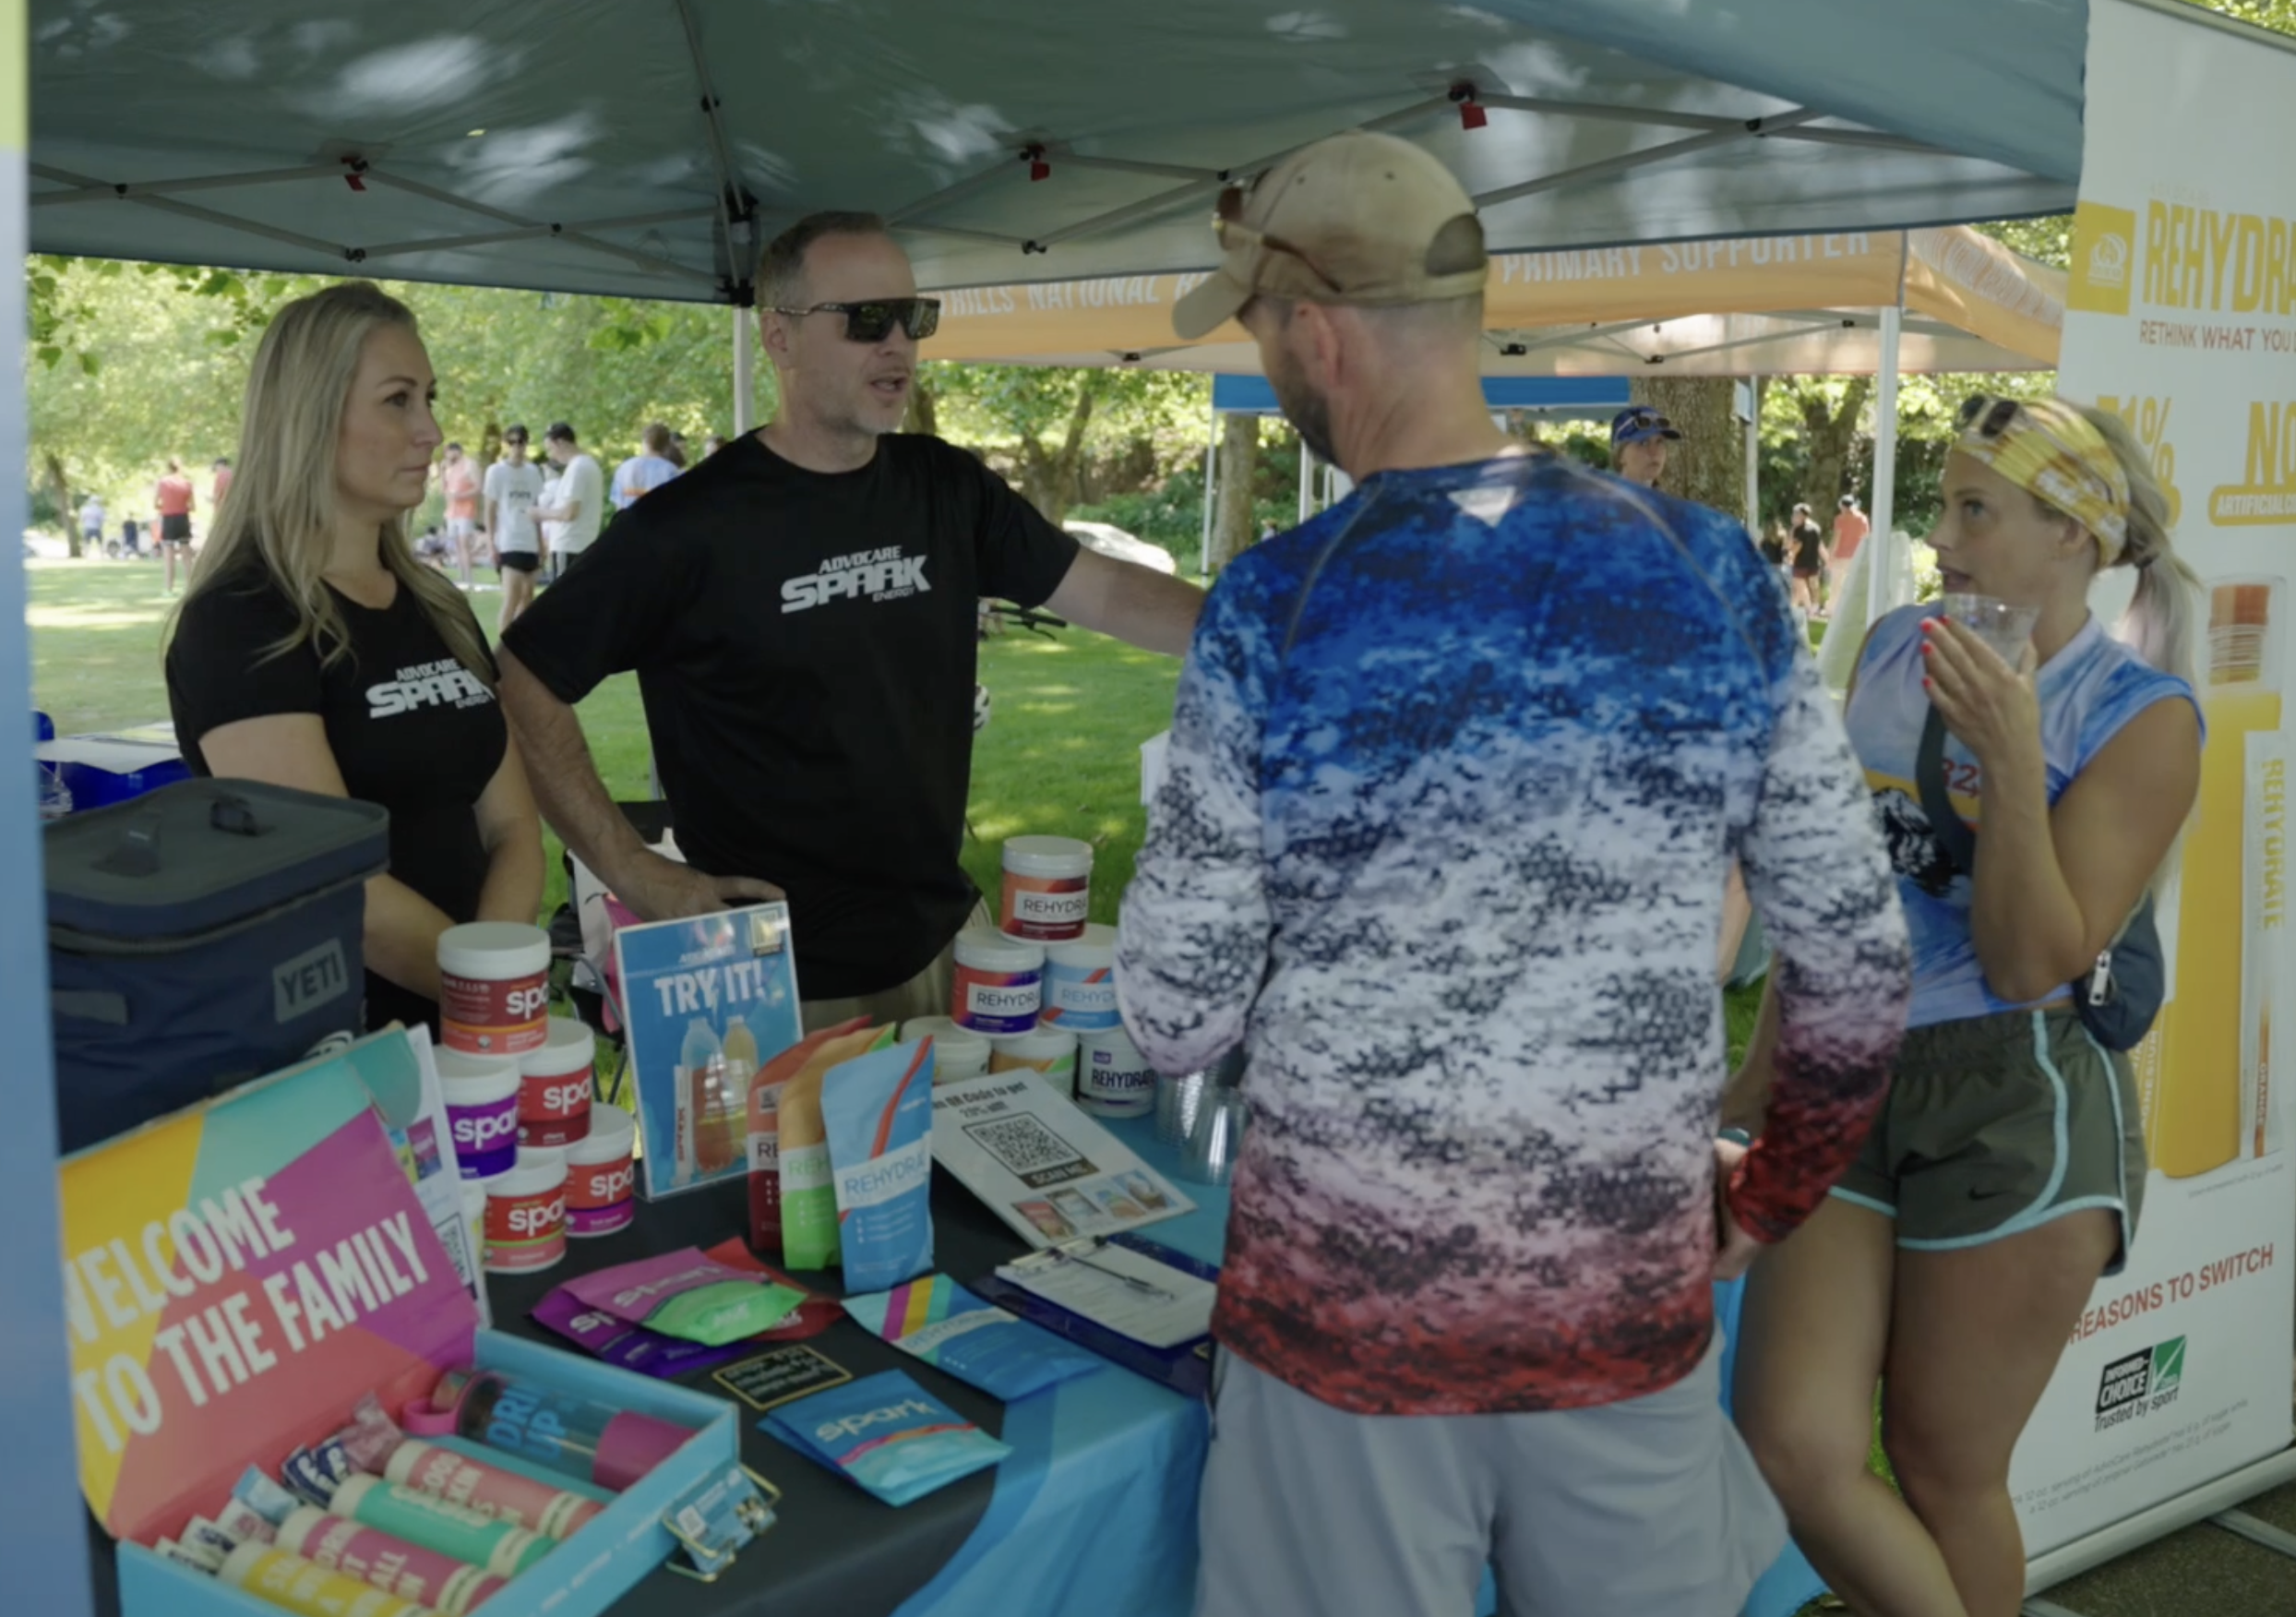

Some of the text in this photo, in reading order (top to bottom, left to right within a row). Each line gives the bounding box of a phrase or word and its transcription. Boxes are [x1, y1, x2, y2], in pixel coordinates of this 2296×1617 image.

[1501, 246, 1643, 283] PRIMARY
[1662, 232, 1871, 274] SUPPORTER
[1027, 276, 1161, 311] NATIONAL
[2139, 319, 2291, 353] RETHINK WHAT YOU
[819, 545, 902, 574] ADVOCARE
[781, 555, 932, 614] SPARK
[872, 586, 916, 603] ENERGY
[396, 658, 460, 682] ADVOCARE
[2262, 759, 2285, 930] REHYDRATE
[280, 951, 341, 1007] YETI
[654, 959, 765, 1017] TRY IT!
[1030, 1168, 1065, 1184] SCAN
[2167, 1272, 2194, 1303] TO
[2199, 1243, 2274, 1292] SWITCH
[73, 1211, 428, 1455] TO THE FAMILY
[2095, 1387, 2179, 1433] Trusted by sport
[2100, 1371, 2147, 1407] CHOICE
[815, 1399, 939, 1443] spark
